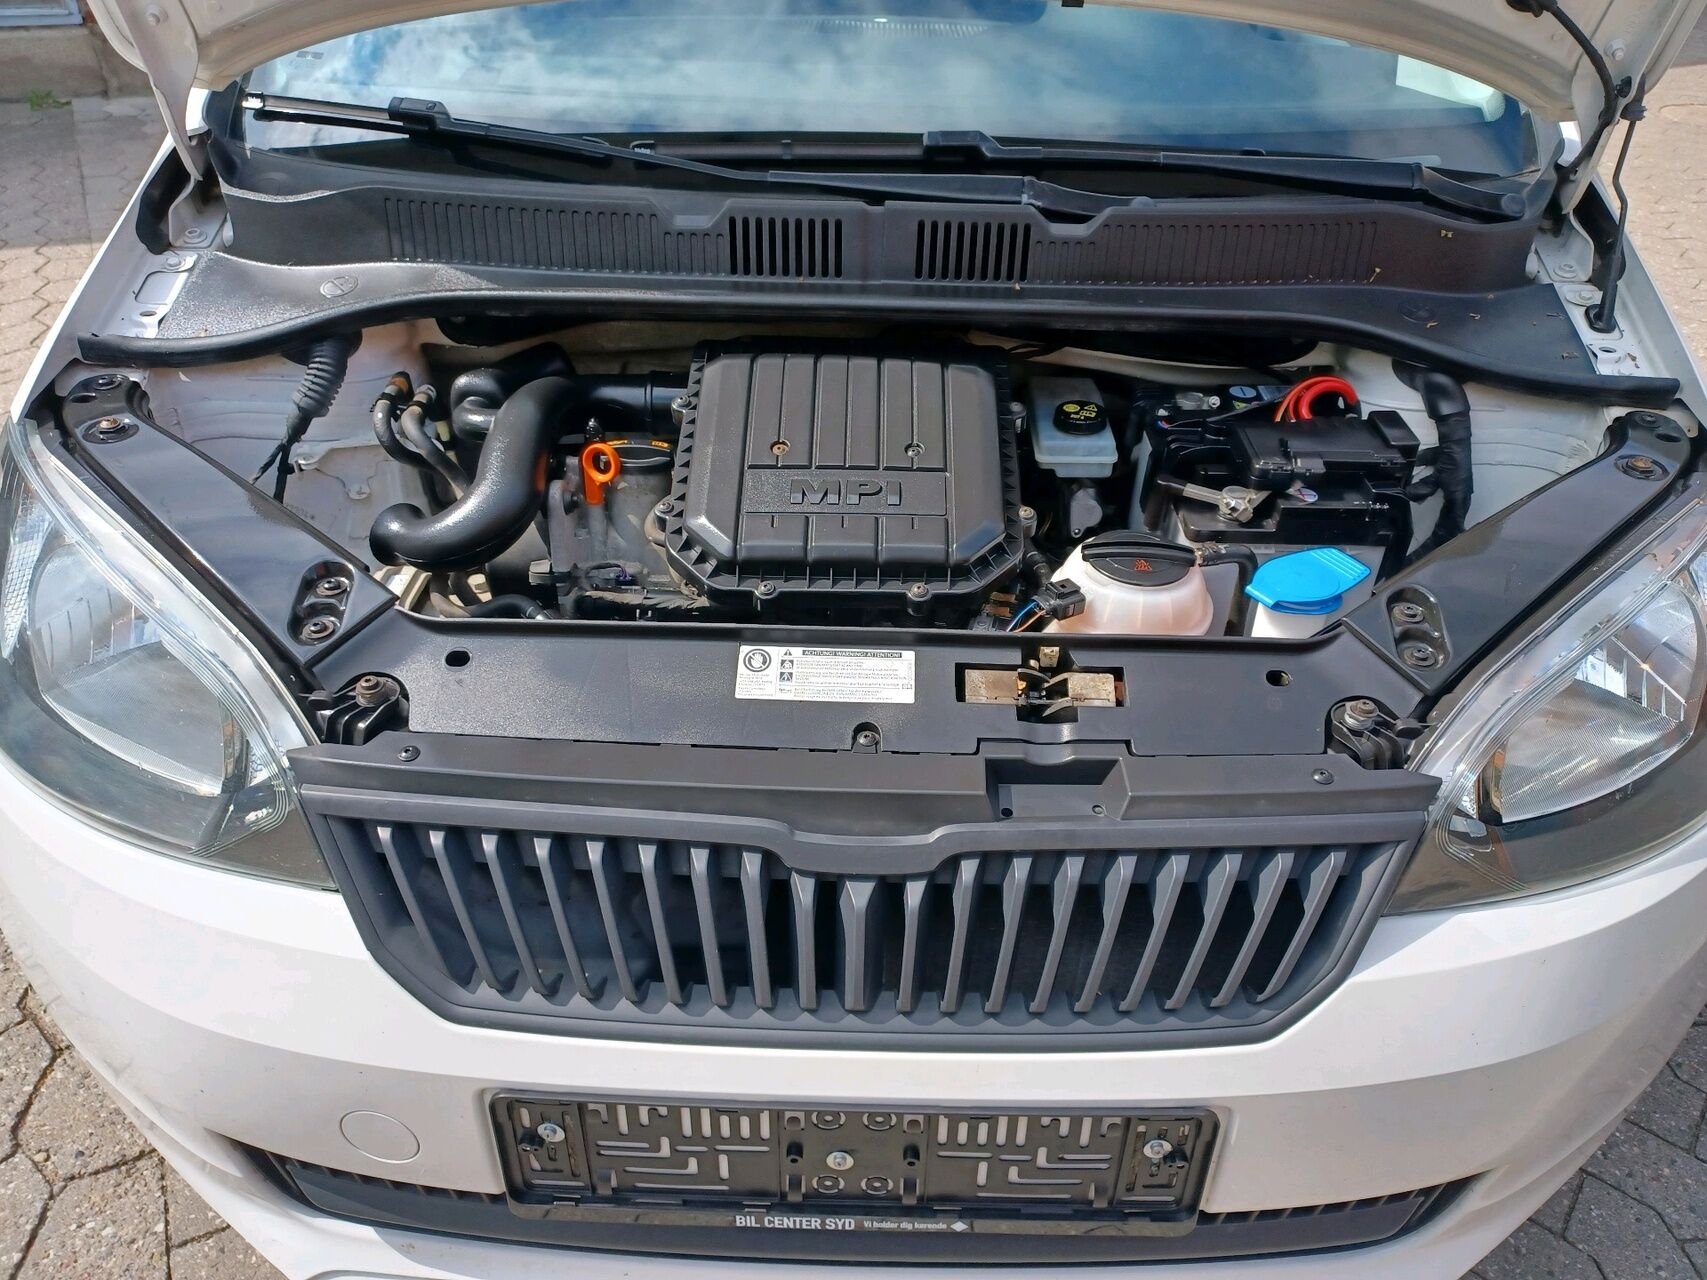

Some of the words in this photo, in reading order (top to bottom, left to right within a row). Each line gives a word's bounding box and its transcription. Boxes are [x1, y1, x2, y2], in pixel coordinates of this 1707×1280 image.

[790, 479, 902, 506] MPI
[735, 1215, 760, 1227] BIL
[764, 1216, 821, 1229] CENTER
[825, 1218, 855, 1230] SYD
[873, 1221, 899, 1229] holder
[900, 1221, 913, 1230] dig
